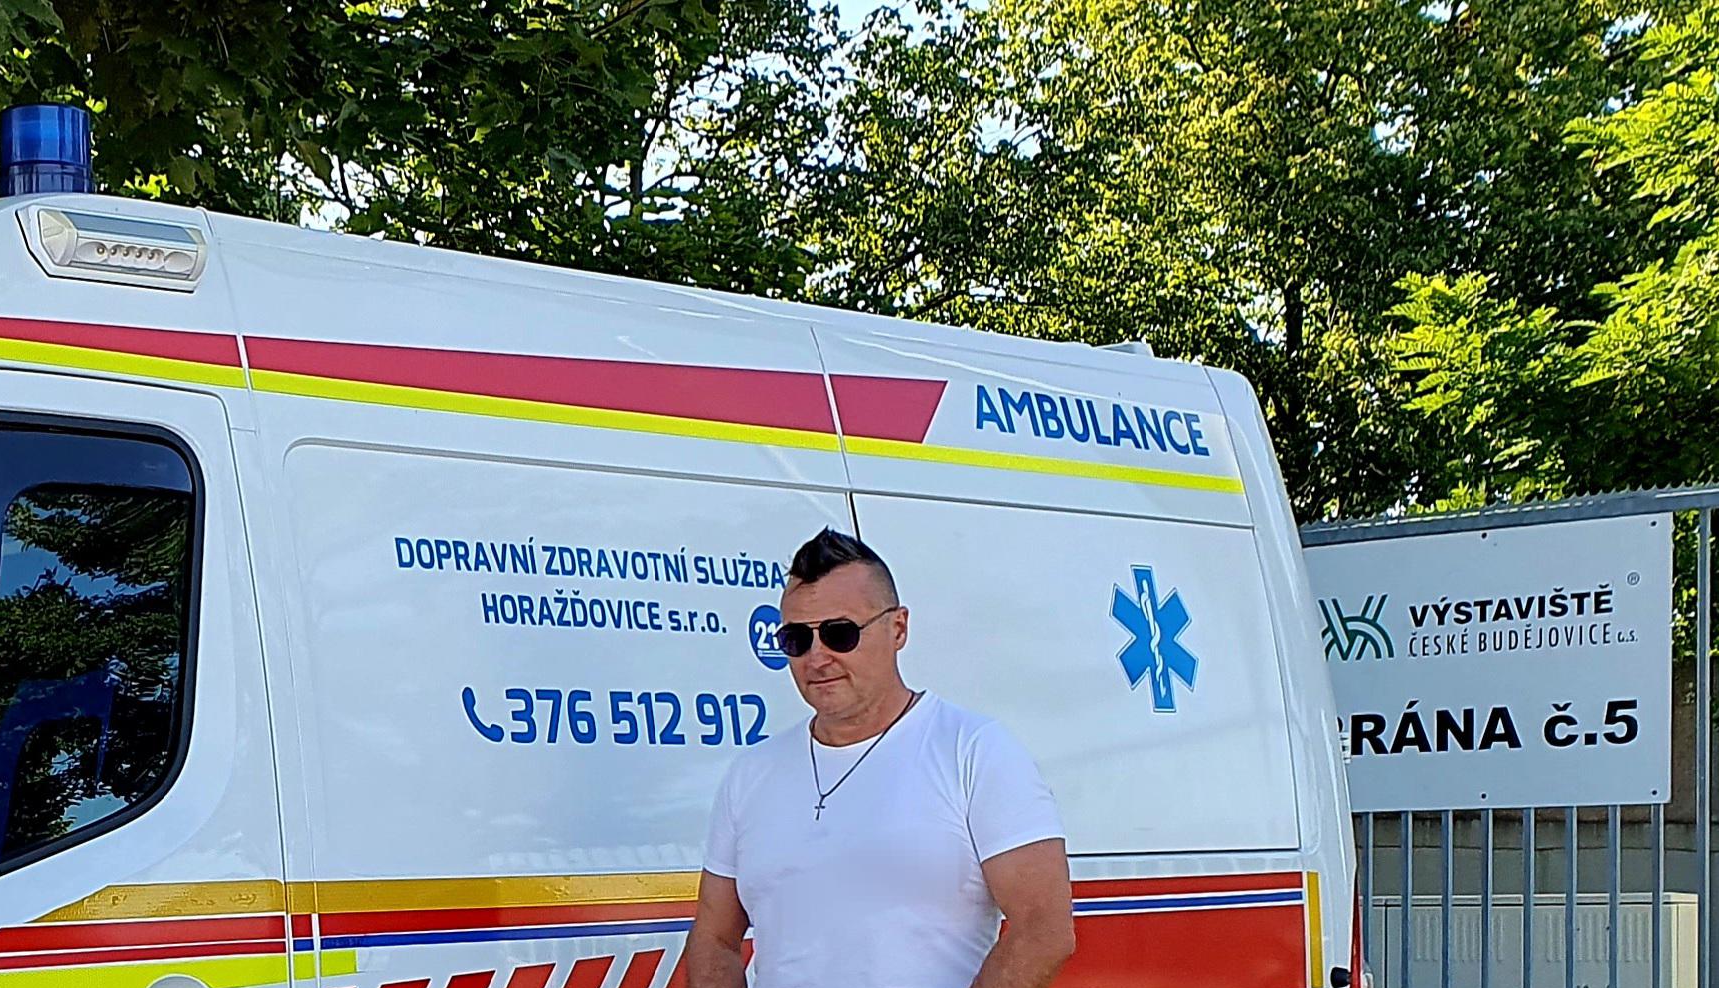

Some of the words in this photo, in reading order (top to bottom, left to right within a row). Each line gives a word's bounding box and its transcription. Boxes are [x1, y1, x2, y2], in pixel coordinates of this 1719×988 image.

[975, 384, 1211, 457] AMBULANCE
[394, 536, 537, 576] DOPRAVNÍ
[541, 545, 689, 583] ZDRAVOTNÍ
[694, 552, 784, 590] SLUŽBA
[481, 589, 663, 631] HORAŽĎOVICE
[668, 609, 728, 635] s.r.o.
[1408, 584, 1614, 628] VÝSTAVIŠTĚ
[1407, 629, 1469, 658] ČESKÉ
[1478, 622, 1612, 653] BUDĚJOVICE
[504, 688, 598, 745] 376
[610, 692, 686, 746] 512
[695, 693, 771, 746] 912
[1337, 700, 1522, 757] RÁNA
